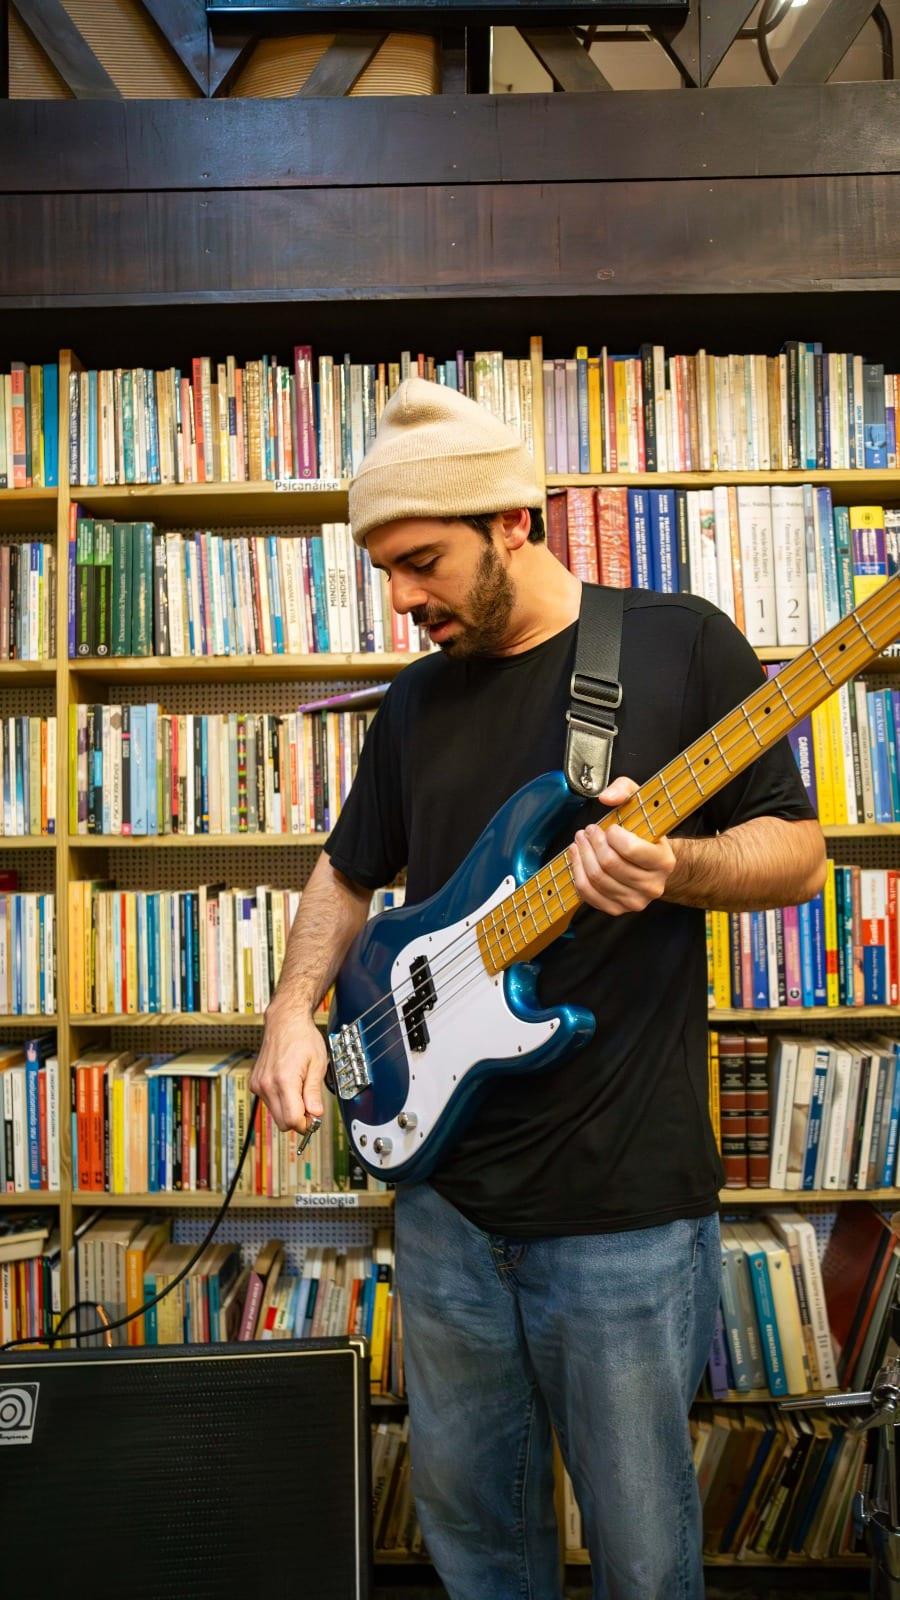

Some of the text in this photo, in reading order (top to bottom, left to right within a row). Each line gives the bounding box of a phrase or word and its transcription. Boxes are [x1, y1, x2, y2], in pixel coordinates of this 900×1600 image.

[275, 481, 338, 491] Psicanálise
[329, 568, 337, 607] MINDSET
[339, 568, 347, 608] MINDSET
[756, 598, 765, 618] 1
[787, 598, 800, 619] 2
[798, 736, 811, 788] CARDIOLOGIA
[295, 1195, 355, 1208] Psicologia
[766, 1324, 779, 1373] REUMATOLOGIA
